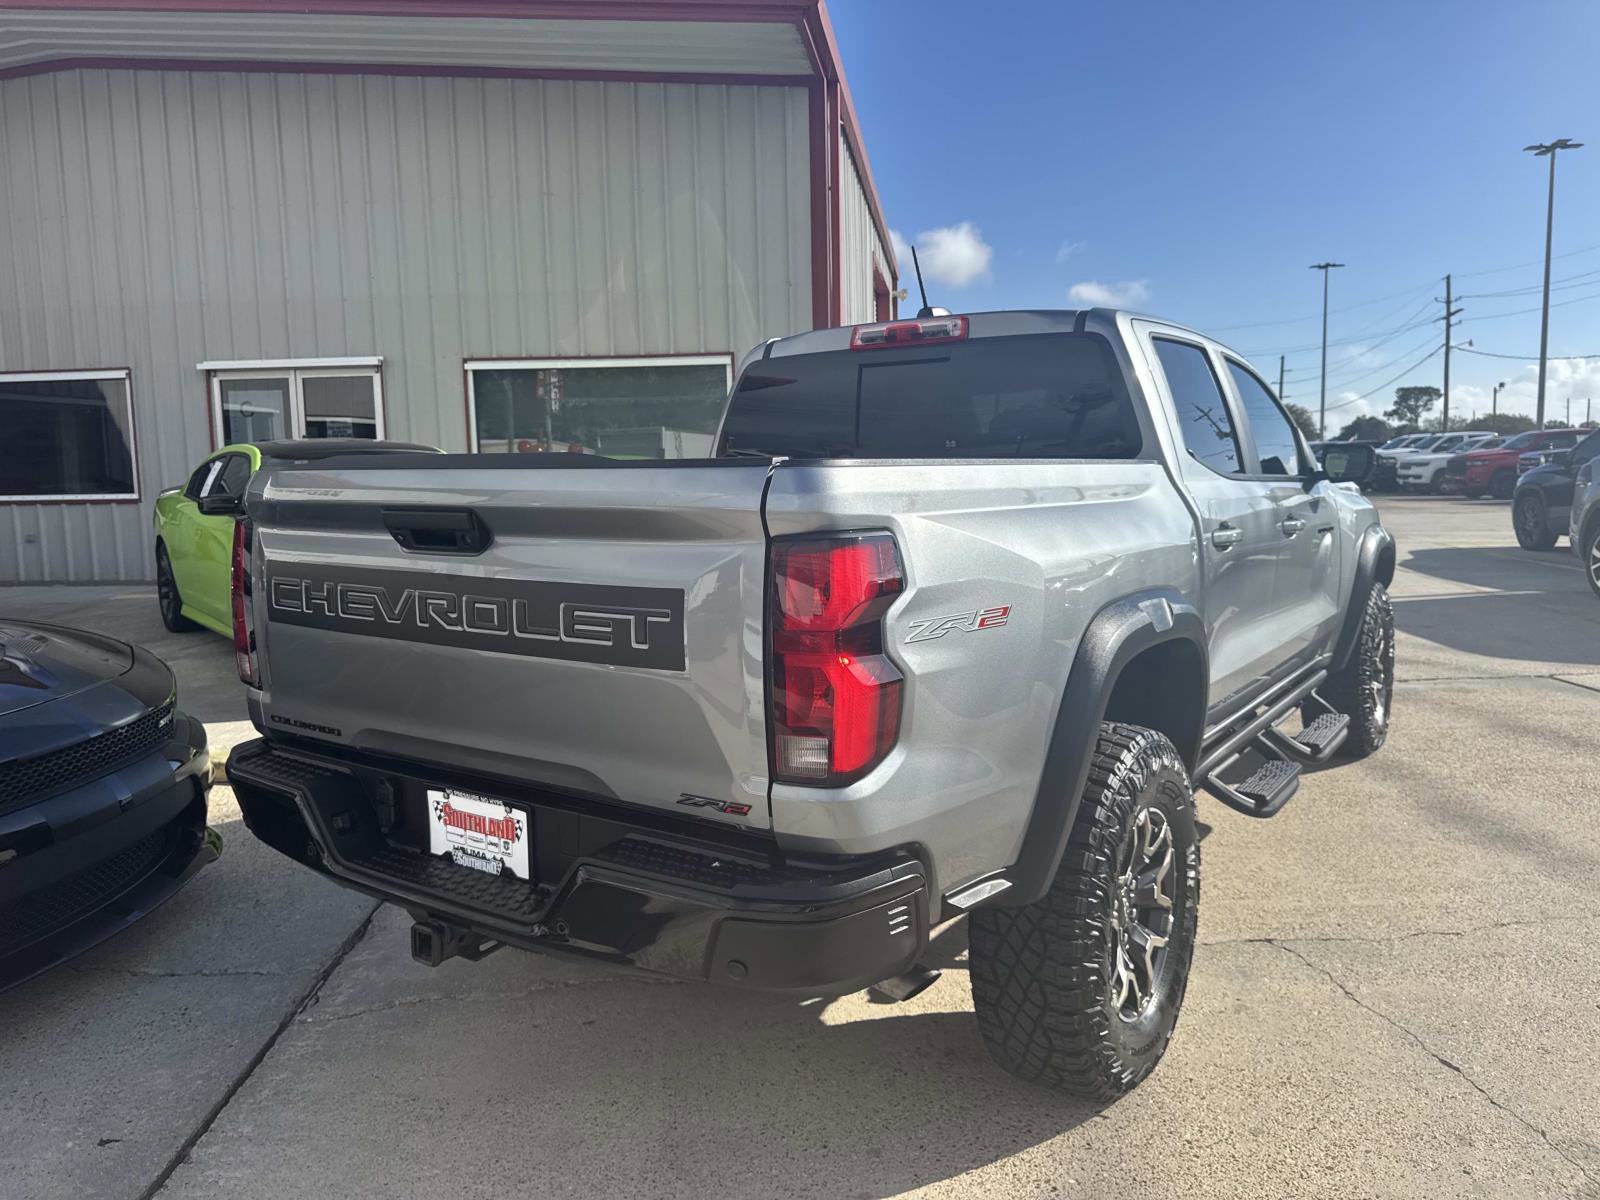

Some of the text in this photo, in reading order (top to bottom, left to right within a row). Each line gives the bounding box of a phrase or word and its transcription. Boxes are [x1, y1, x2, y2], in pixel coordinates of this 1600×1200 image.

[271, 576, 671, 649] CHEVROLET
[904, 604, 1012, 645] ZR2
[270, 714, 343, 737] COLORADO
[676, 793, 753, 816] ZR2
[442, 801, 516, 844] SOUTHLAND
[457, 852, 497, 875] SOUTHLAND
